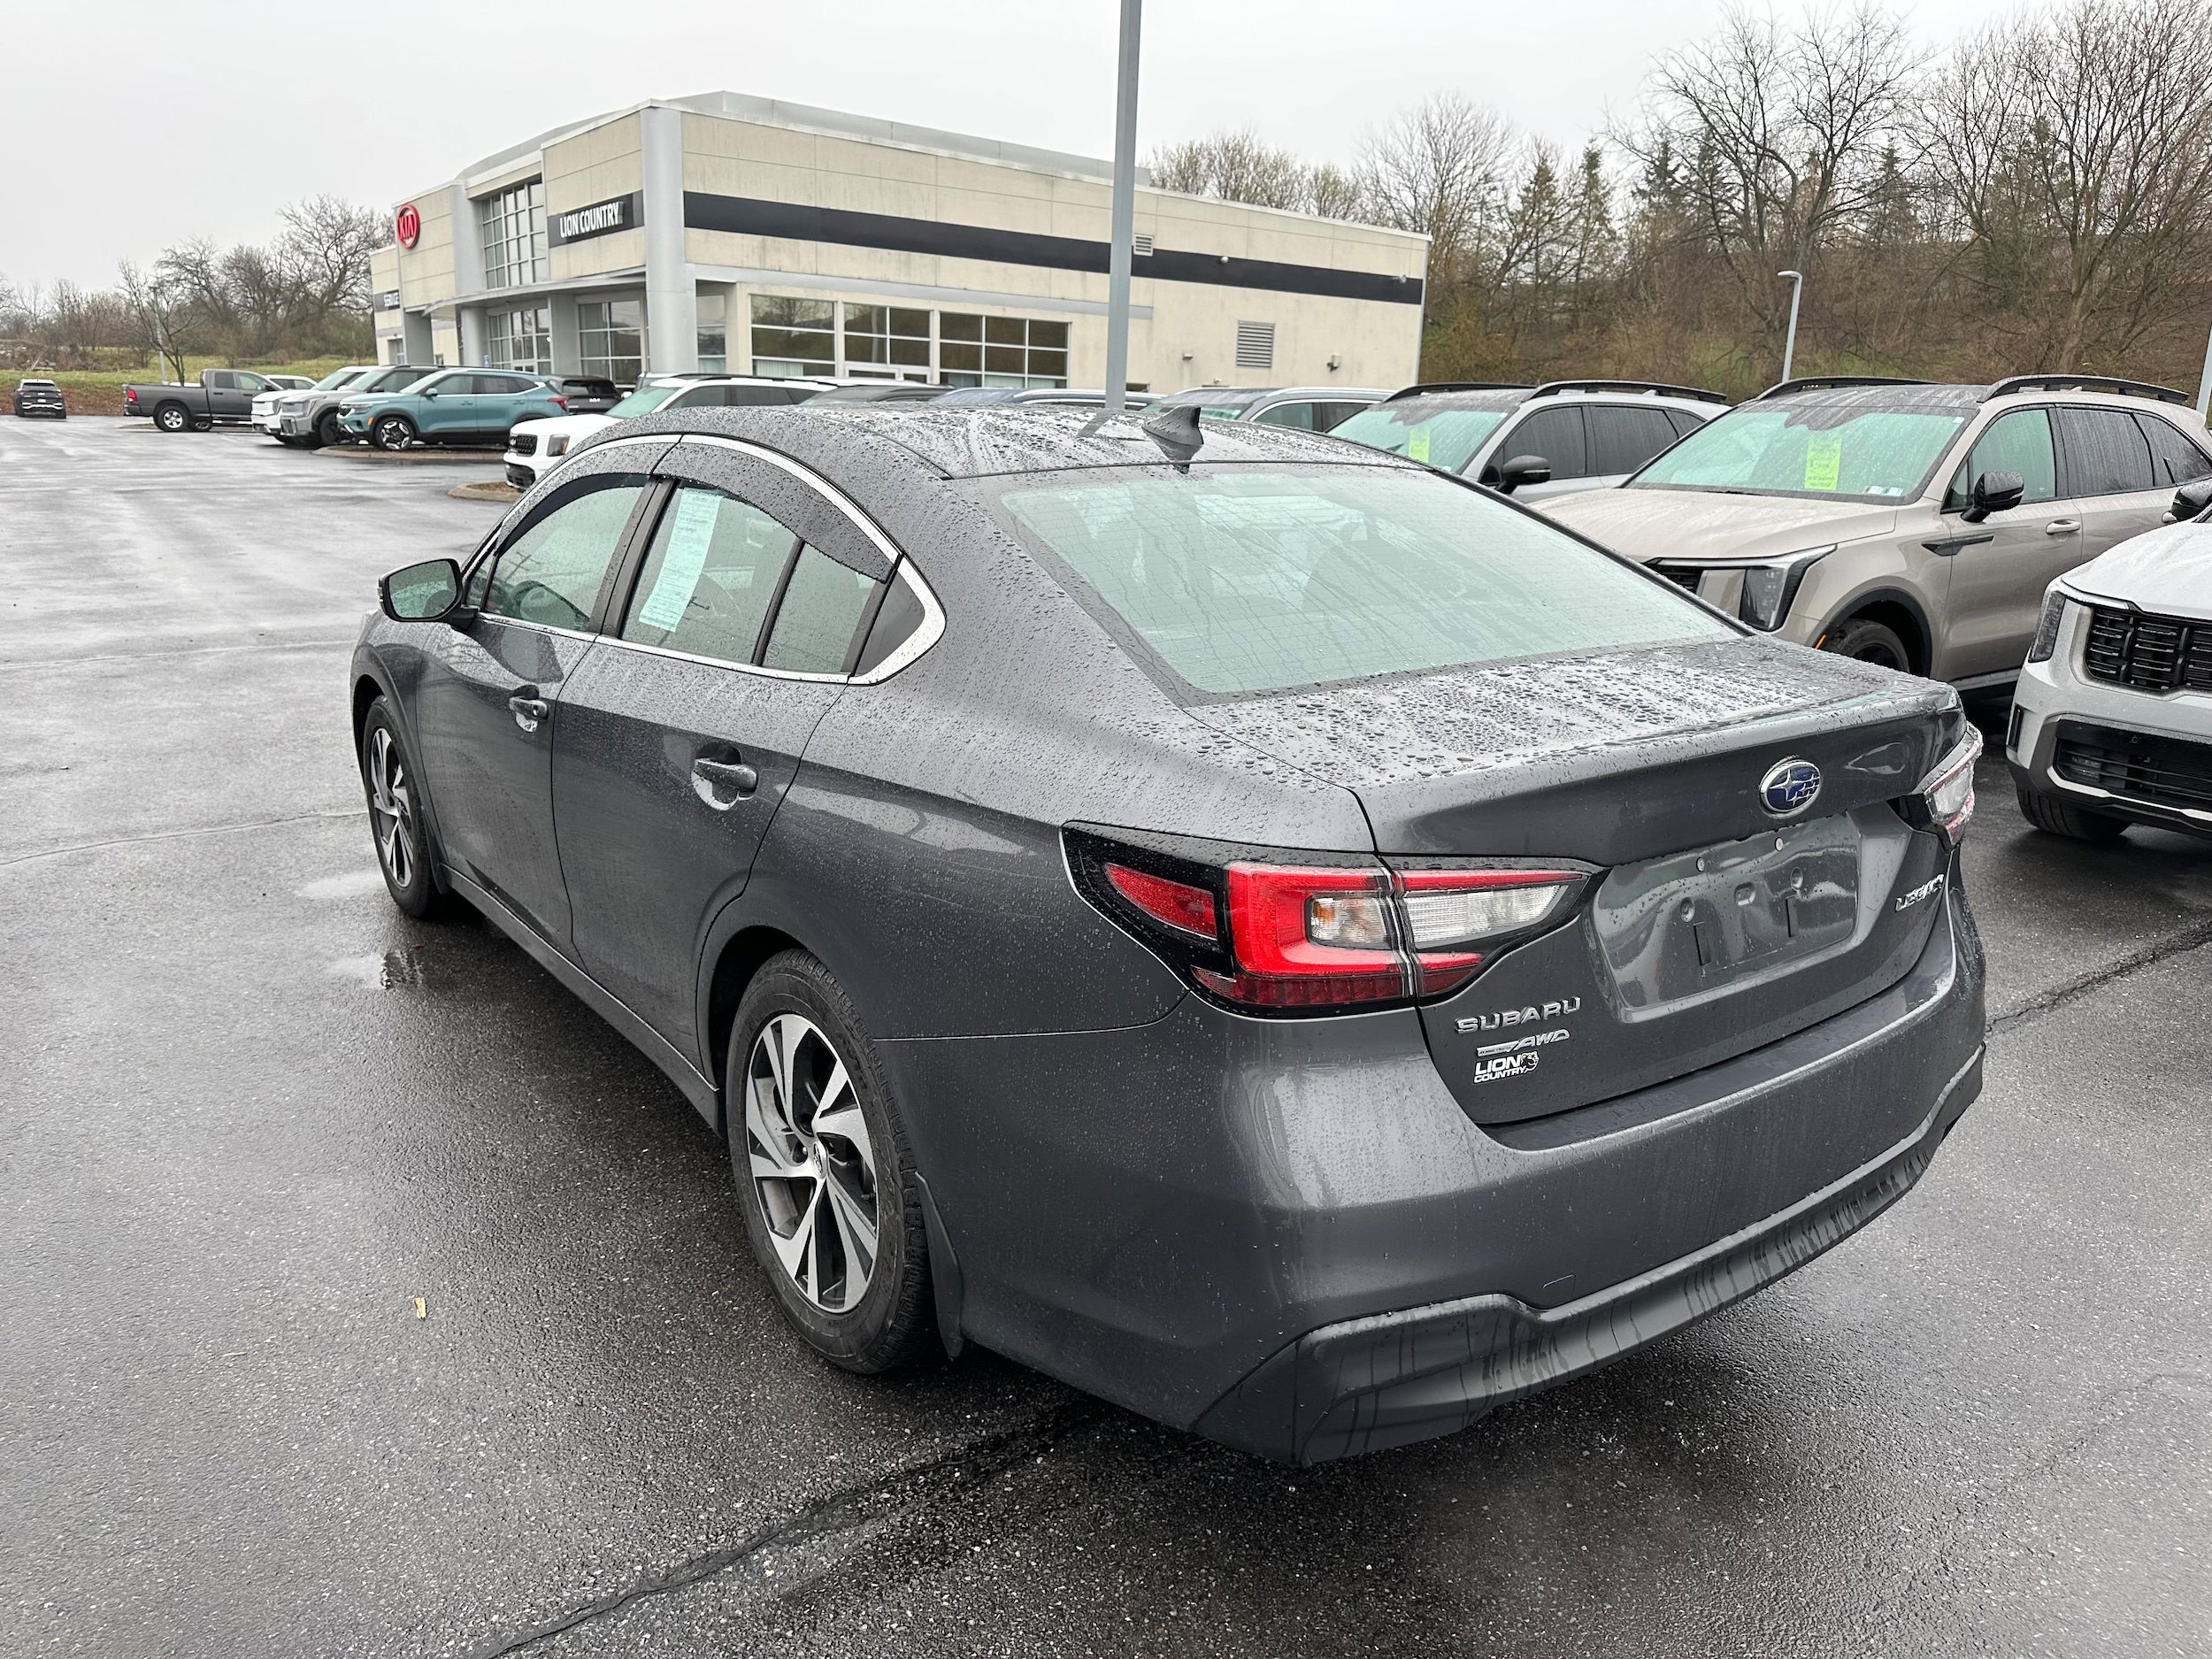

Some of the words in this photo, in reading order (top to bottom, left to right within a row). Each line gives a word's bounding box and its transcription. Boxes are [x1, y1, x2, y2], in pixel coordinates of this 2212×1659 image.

[559, 213, 580, 238] LION
[580, 201, 623, 233] COUNTRY
[1455, 996, 1581, 1033] SUBARU
[1514, 1029, 1571, 1051] AWD
[1474, 1065, 1526, 1083] COUNTRY
[1475, 1054, 1522, 1076] LION
